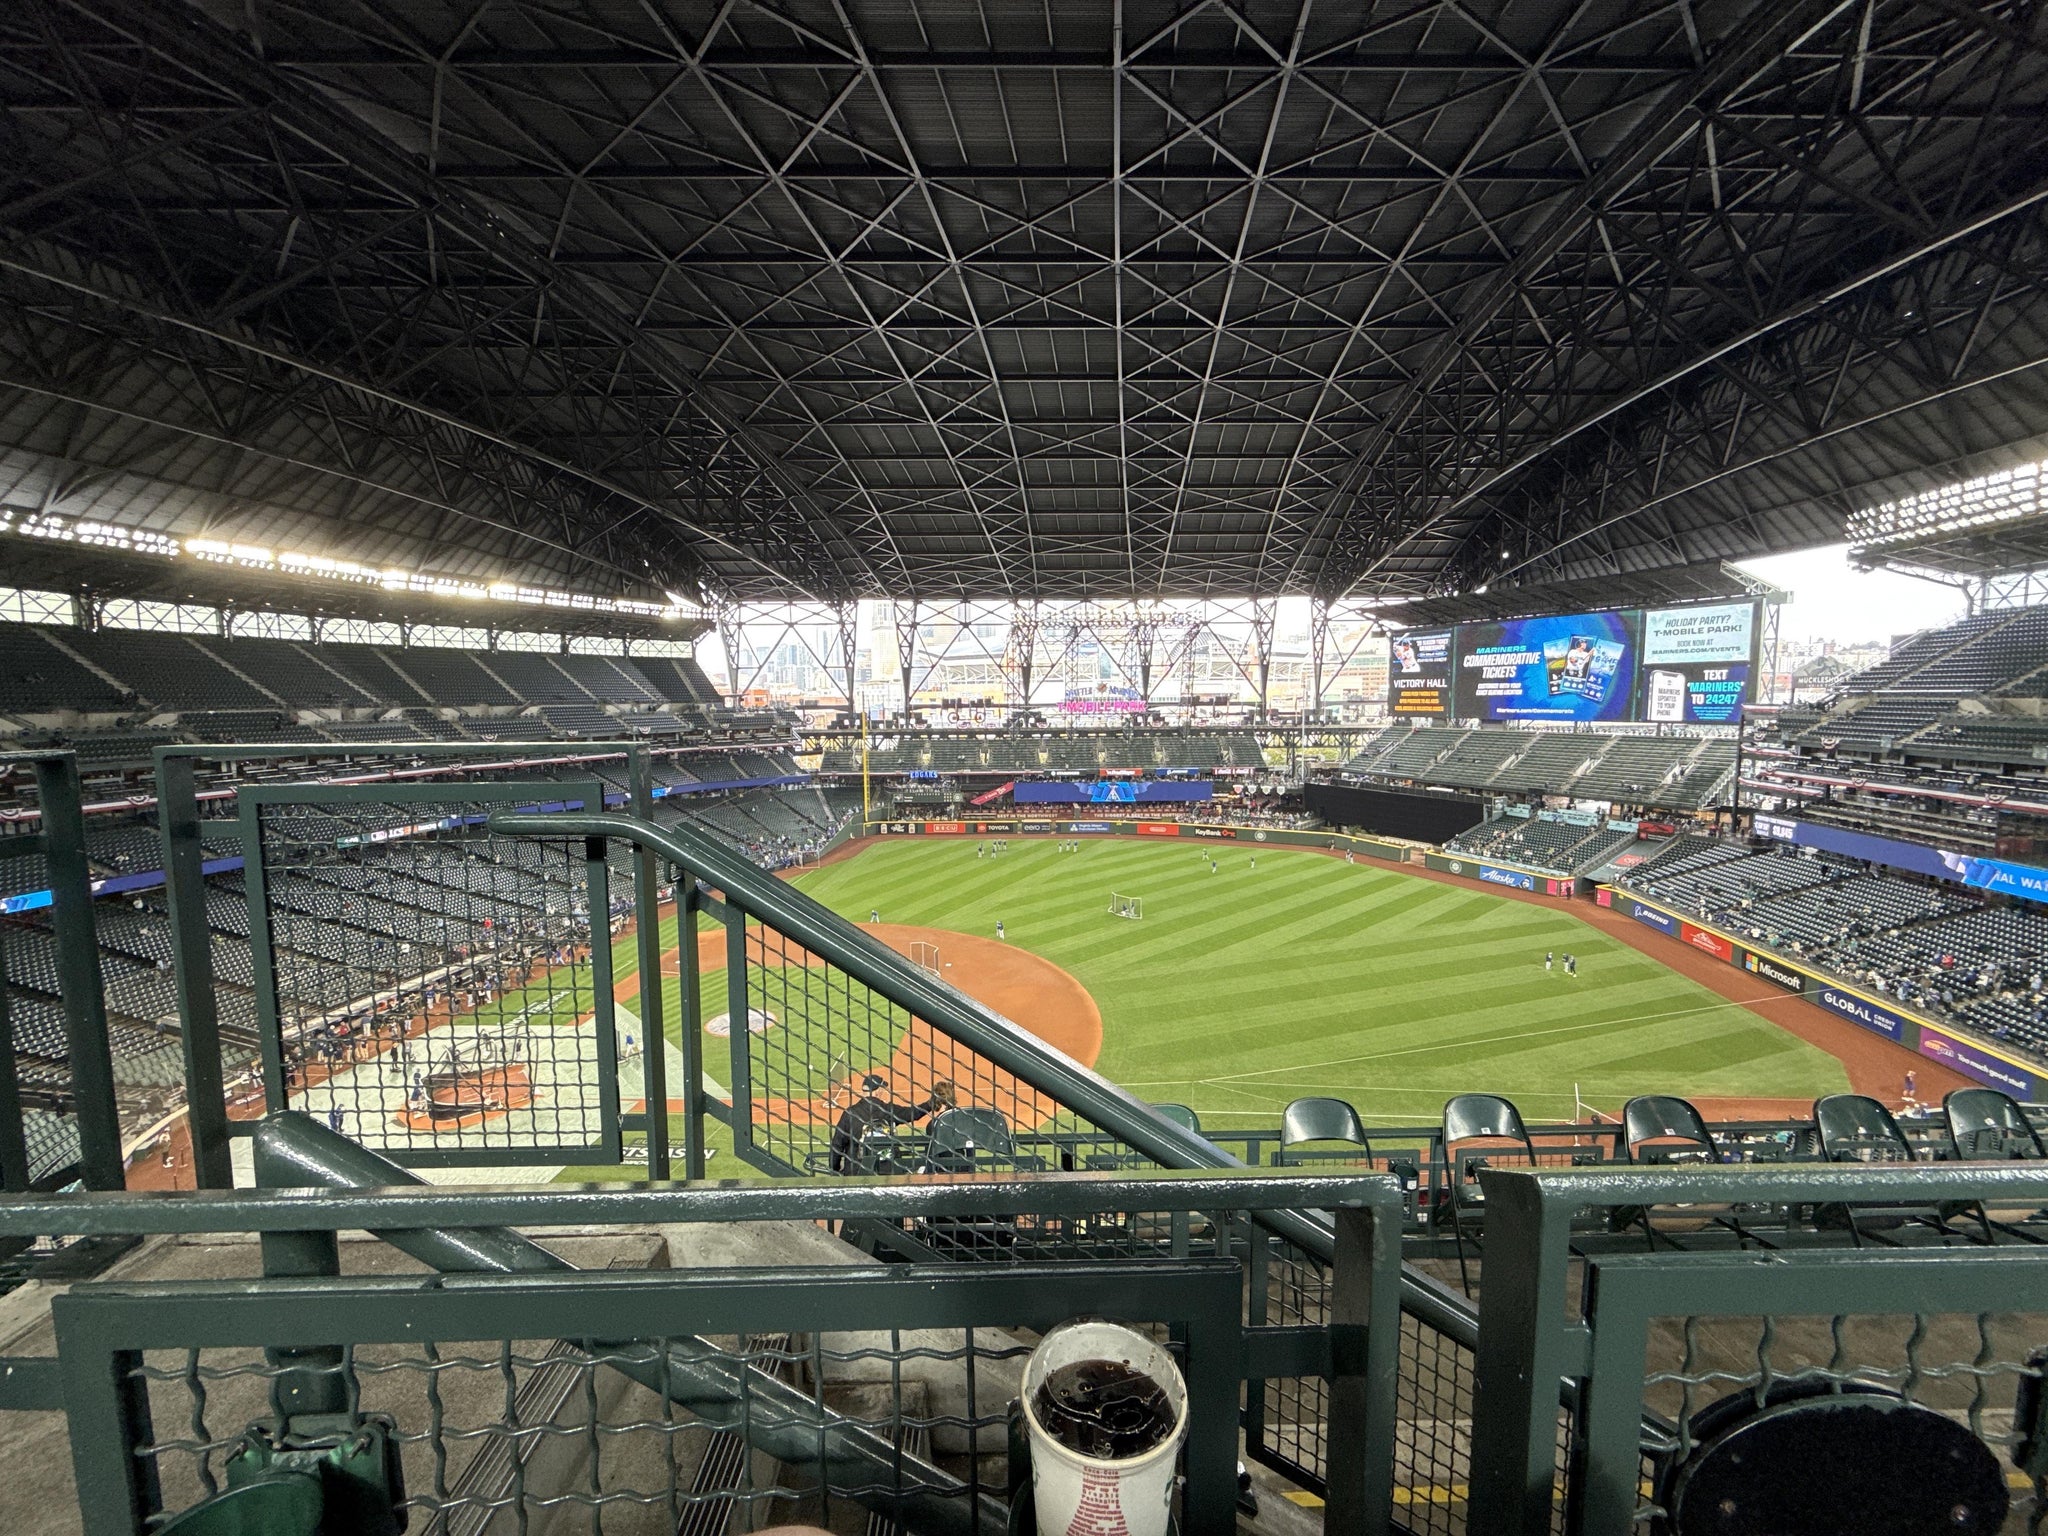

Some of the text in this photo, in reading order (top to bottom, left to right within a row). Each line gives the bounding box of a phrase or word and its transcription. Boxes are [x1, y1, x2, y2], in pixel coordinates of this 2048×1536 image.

[1666, 614, 1731, 628] HOLIDAY PARTY?
[1654, 624, 1742, 636] T-MOBILE PARK!
[1476, 646, 1526, 654] MARINERS
[1652, 646, 1740, 654] MARINERS.COM/EVENTS
[1463, 652, 1541, 667] COMMEMORATIVE
[1482, 666, 1517, 678] TICKETS
[1703, 670, 1728, 680] TEXT
[1393, 678, 1448, 688] VICTORY HALL
[1691, 694, 1738, 704] TO 24247
[1056, 700, 1146, 713] T-MOBILE PARK
[1482, 870, 1516, 885] Alaska
[1642, 910, 1669, 925] BOEING
[1759, 962, 1800, 990] Microsoft
[1824, 992, 1872, 1022] GLOBAL
[1873, 1020, 1893, 1032] UNION
[1874, 1014, 1896, 1027] CREDIT
[1957, 1053, 1970, 1064] Too
[1970, 1060, 1988, 1073] much
[1988, 1069, 2008, 1082] good
[1084, 1466, 1118, 1475] Coca-Cola
